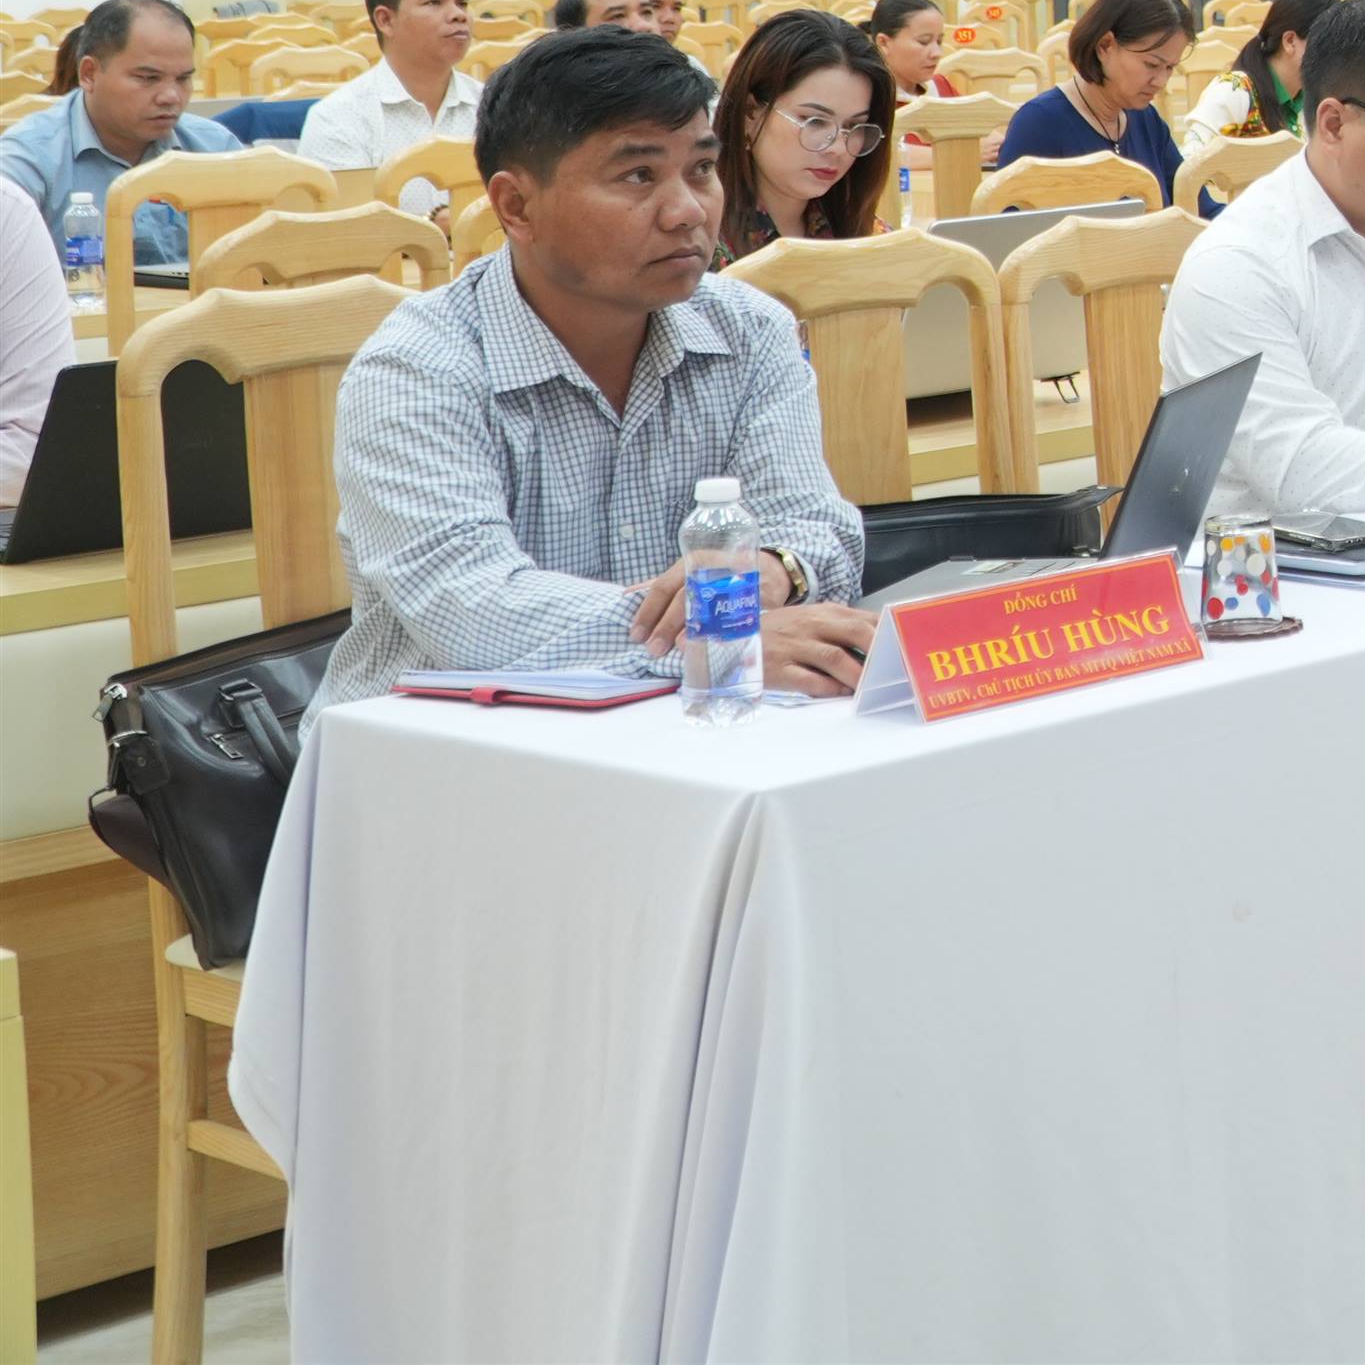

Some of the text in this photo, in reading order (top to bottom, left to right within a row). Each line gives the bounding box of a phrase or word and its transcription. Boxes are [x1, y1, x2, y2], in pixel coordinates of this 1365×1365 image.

[1004, 583, 1078, 615] ĐỒNG CHÍ
[926, 604, 1170, 682] BHRÍU HÙNG
[1002, 674, 1035, 694] TỊCH
[1035, 668, 1053, 685] ỦY
[1055, 663, 1080, 681] BAN
[1118, 648, 1146, 667] VIỆT
[1146, 642, 1175, 660] NAM
